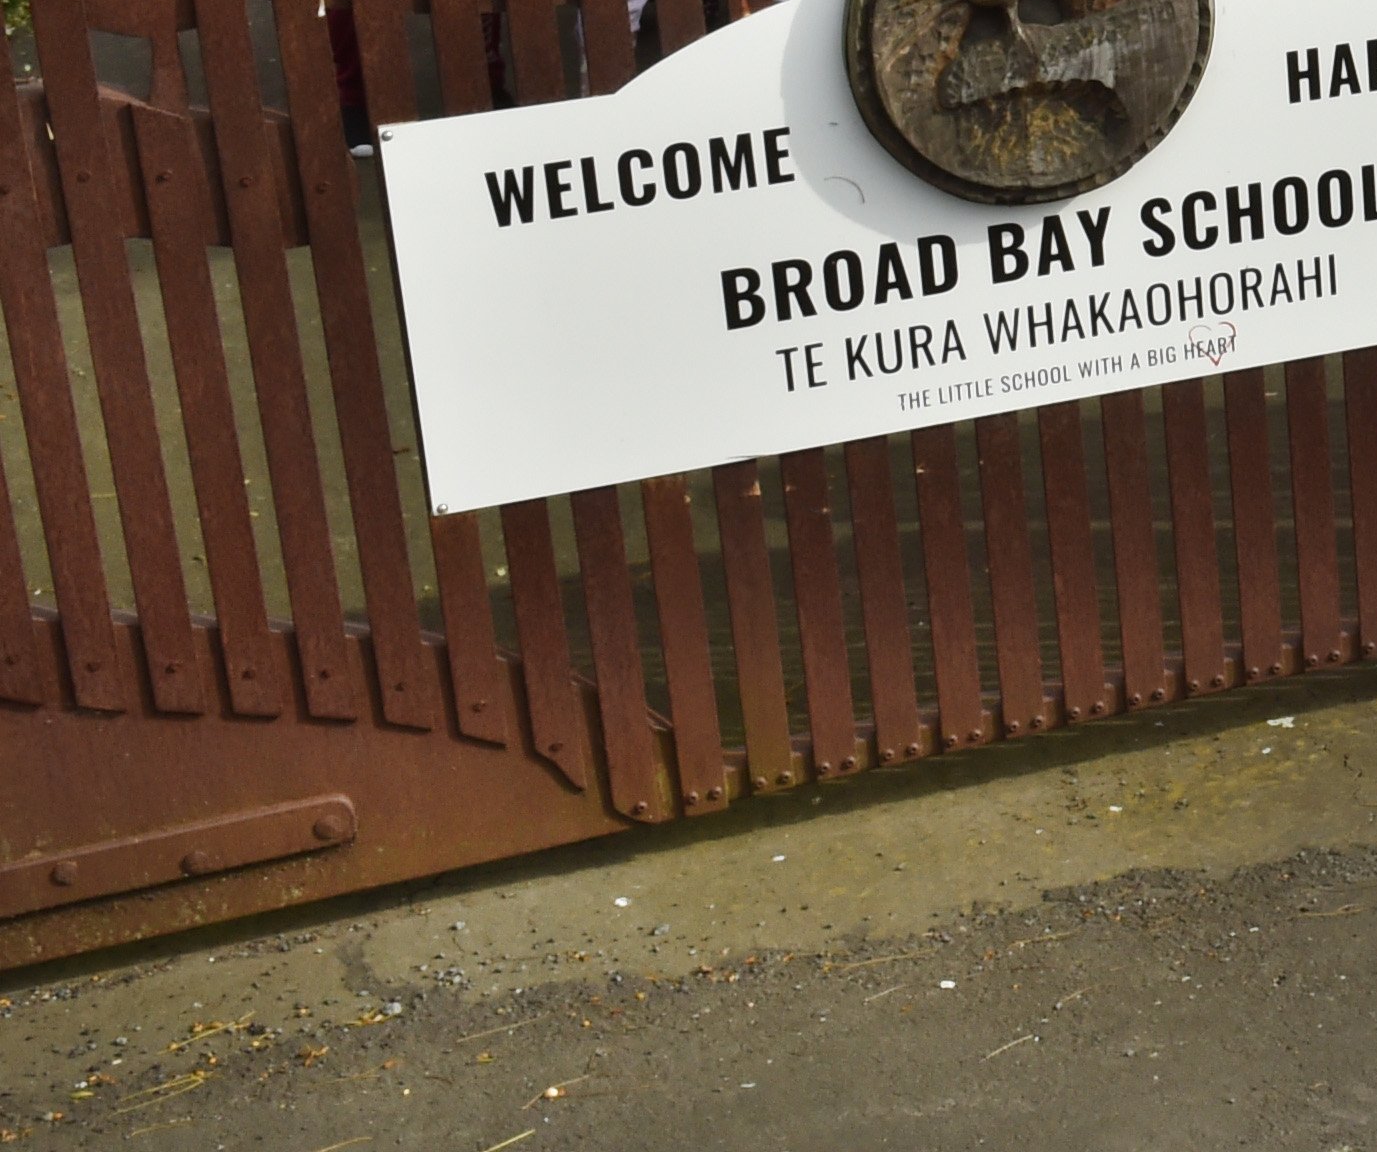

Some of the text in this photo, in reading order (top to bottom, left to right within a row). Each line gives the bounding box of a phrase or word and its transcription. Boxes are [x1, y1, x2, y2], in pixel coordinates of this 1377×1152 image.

[484, 126, 795, 228] WELCOME
[720, 234, 959, 330] BROAD
[987, 206, 1111, 284] BAY
[775, 253, 1337, 392] TE KURA WHAKAOHORAHI
[898, 334, 1237, 411] THE LITTLE SCHOOL WITH A BIG HEART
